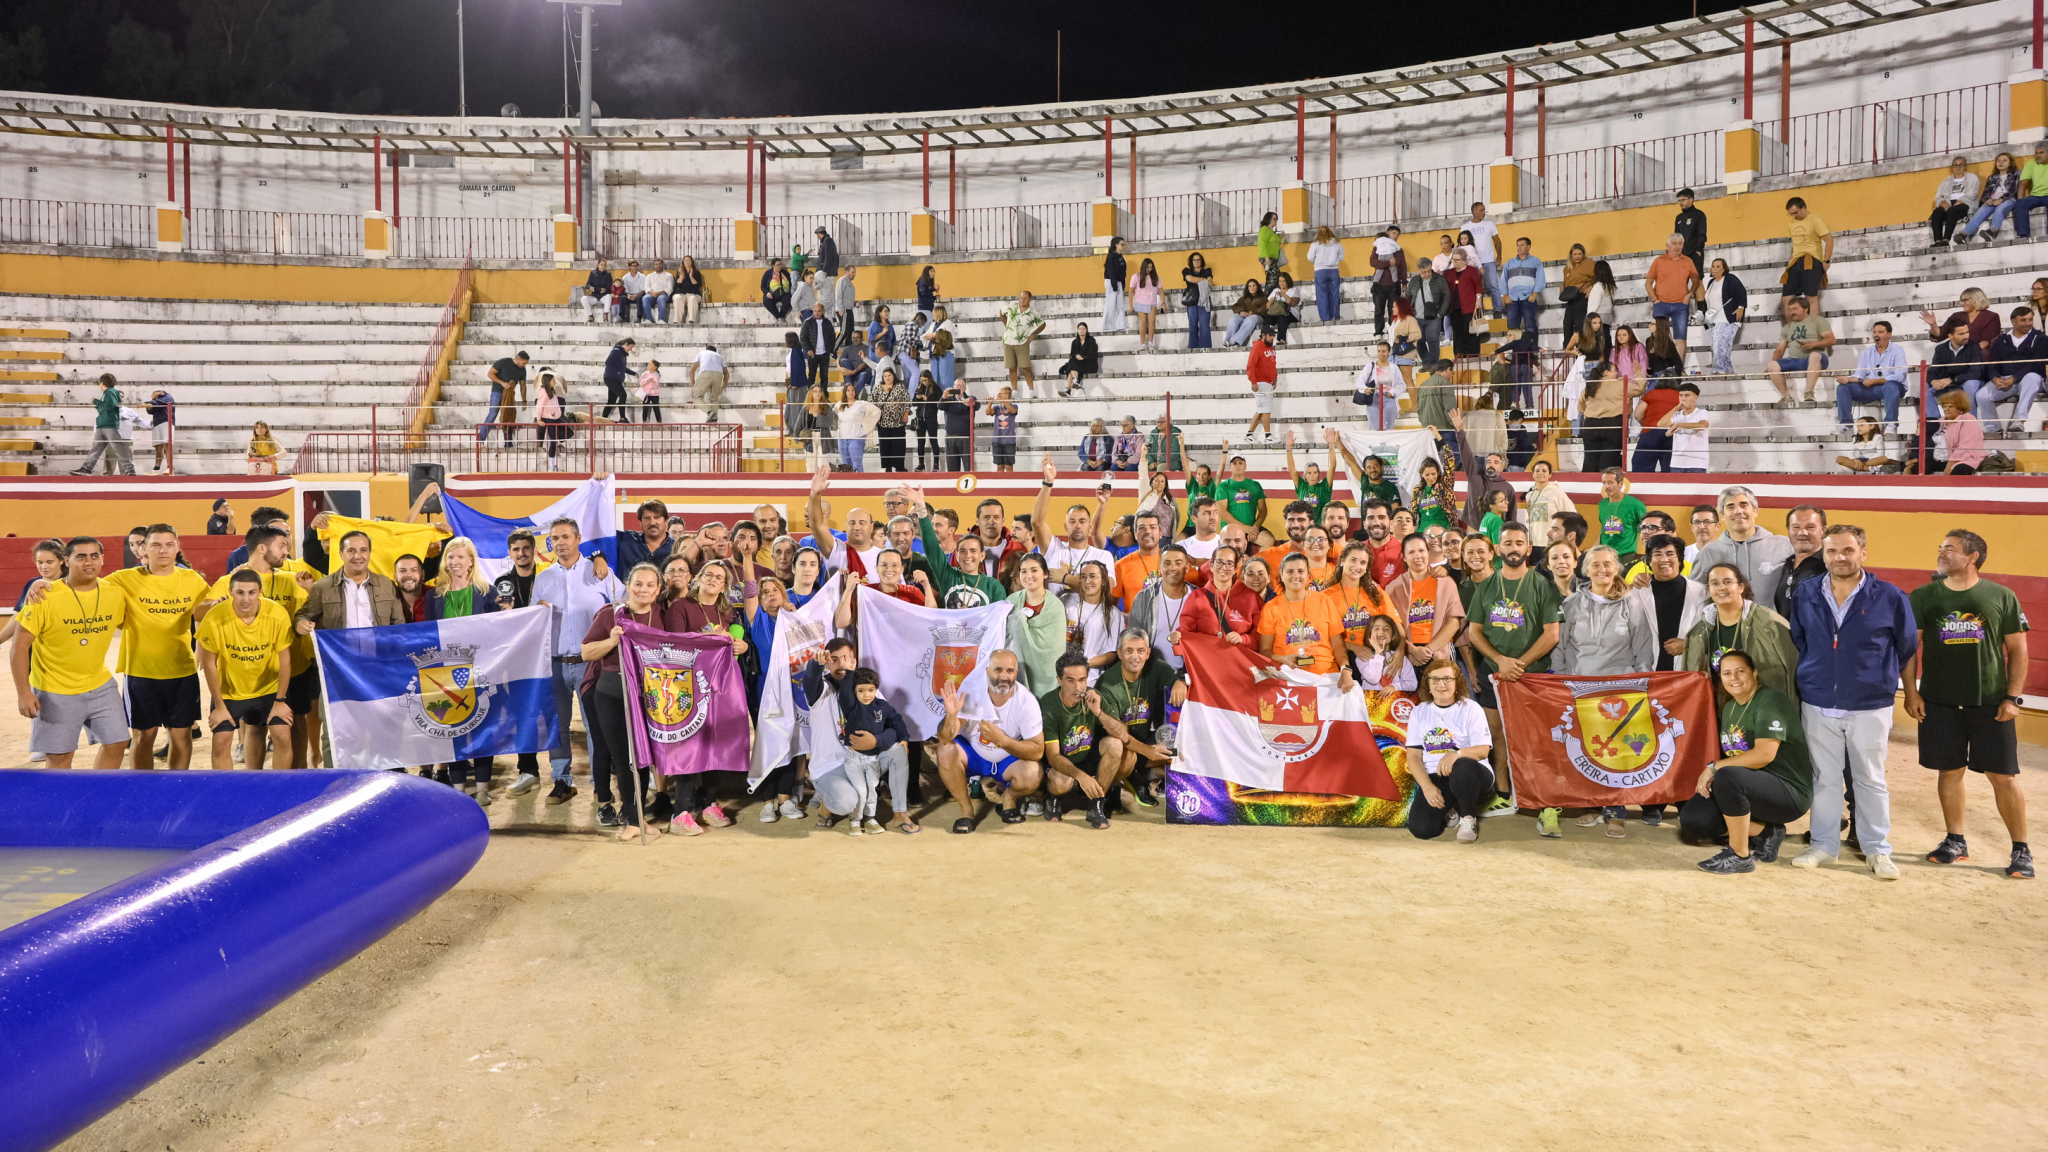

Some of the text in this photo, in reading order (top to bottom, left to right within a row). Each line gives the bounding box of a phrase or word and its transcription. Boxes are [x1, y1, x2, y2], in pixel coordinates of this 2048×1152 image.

[963, 478, 969, 489] 1
[139, 595, 192, 605] VILA CHÃ DE
[148, 606, 187, 615] OURIQUE
[1409, 605, 1435, 616] JOGOS
[62, 614, 113, 626] VILA CHÃ DE
[1943, 621, 1979, 632] JOGOS
[225, 643, 241, 652] VILA
[242, 643, 260, 652] CHÃ
[925, 697, 940, 714] VALE
[414, 707, 487, 738] VILA CHÃ DE OURIQUE
[667, 733, 677, 741] DO
[680, 712, 706, 738] CARTAXO
[1425, 734, 1451, 744] JOGOS
[1261, 745, 1316, 762] PONTEVEL
[1574, 755, 1610, 785] EREIRA
[1621, 752, 1671, 786] CARTAXO
